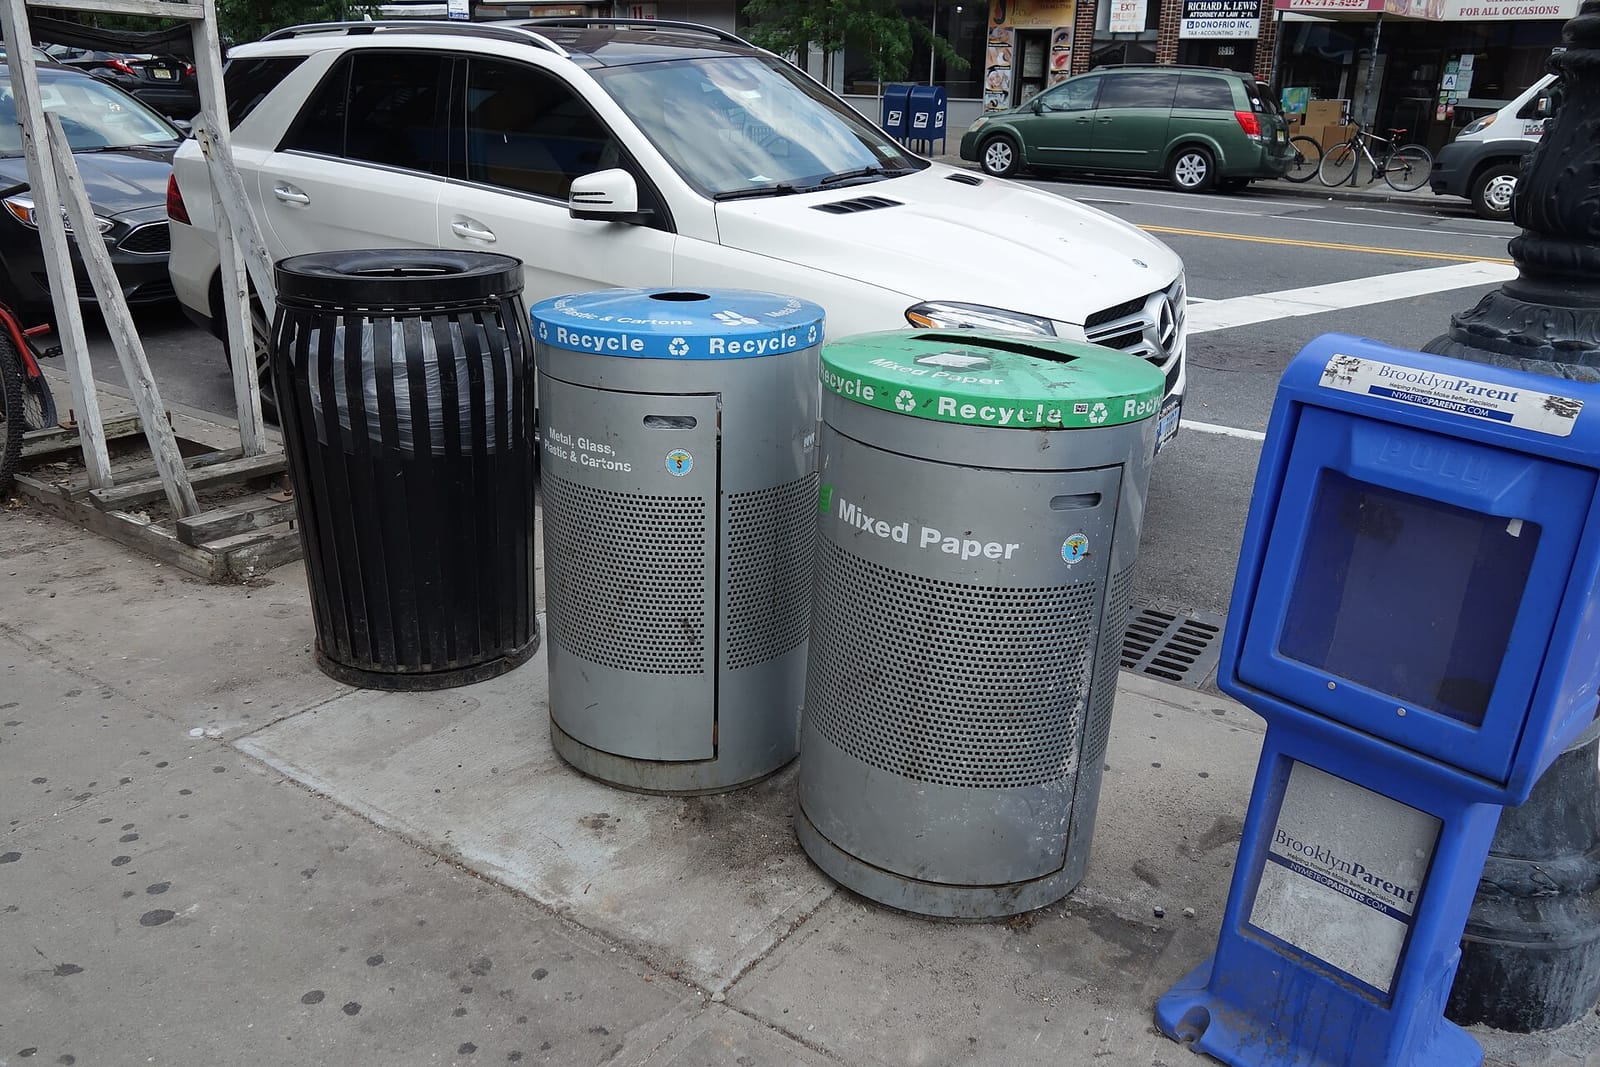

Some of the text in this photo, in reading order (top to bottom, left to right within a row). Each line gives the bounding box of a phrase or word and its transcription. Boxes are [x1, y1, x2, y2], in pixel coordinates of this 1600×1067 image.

[1120, 3, 1136, 11] EXIT
[1187, 1, 1258, 11] RICHARD K. LEWIS
[1459, 6, 1560, 16] FOR ALL OCCASIONS
[1195, 20, 1253, 29] DONOFRIO INC.
[617, 317, 694, 325] Cartons
[557, 326, 645, 352] Recycle
[709, 333, 797, 354] Recycle
[820, 360, 875, 401] Recycle
[868, 358, 1004, 385] Mixed Paper
[1377, 364, 1520, 403] BrooklynParent
[1389, 382, 1498, 408] Helping Parents Make Better Decisions
[1391, 391, 1489, 417] NYMETROPARENTS.COM
[938, 396, 1062, 425] Recycle
[549, 426, 615, 457] Metal, Glass,
[544, 438, 632, 473] Plastic & Cartons
[838, 498, 909, 544] Mixed
[919, 526, 1019, 560] Paper
[1275, 829, 1415, 904] BrooklynParent
[1287, 851, 1309, 867] Helping
[1290, 862, 1388, 913] NYMETROPARENTS.COM
